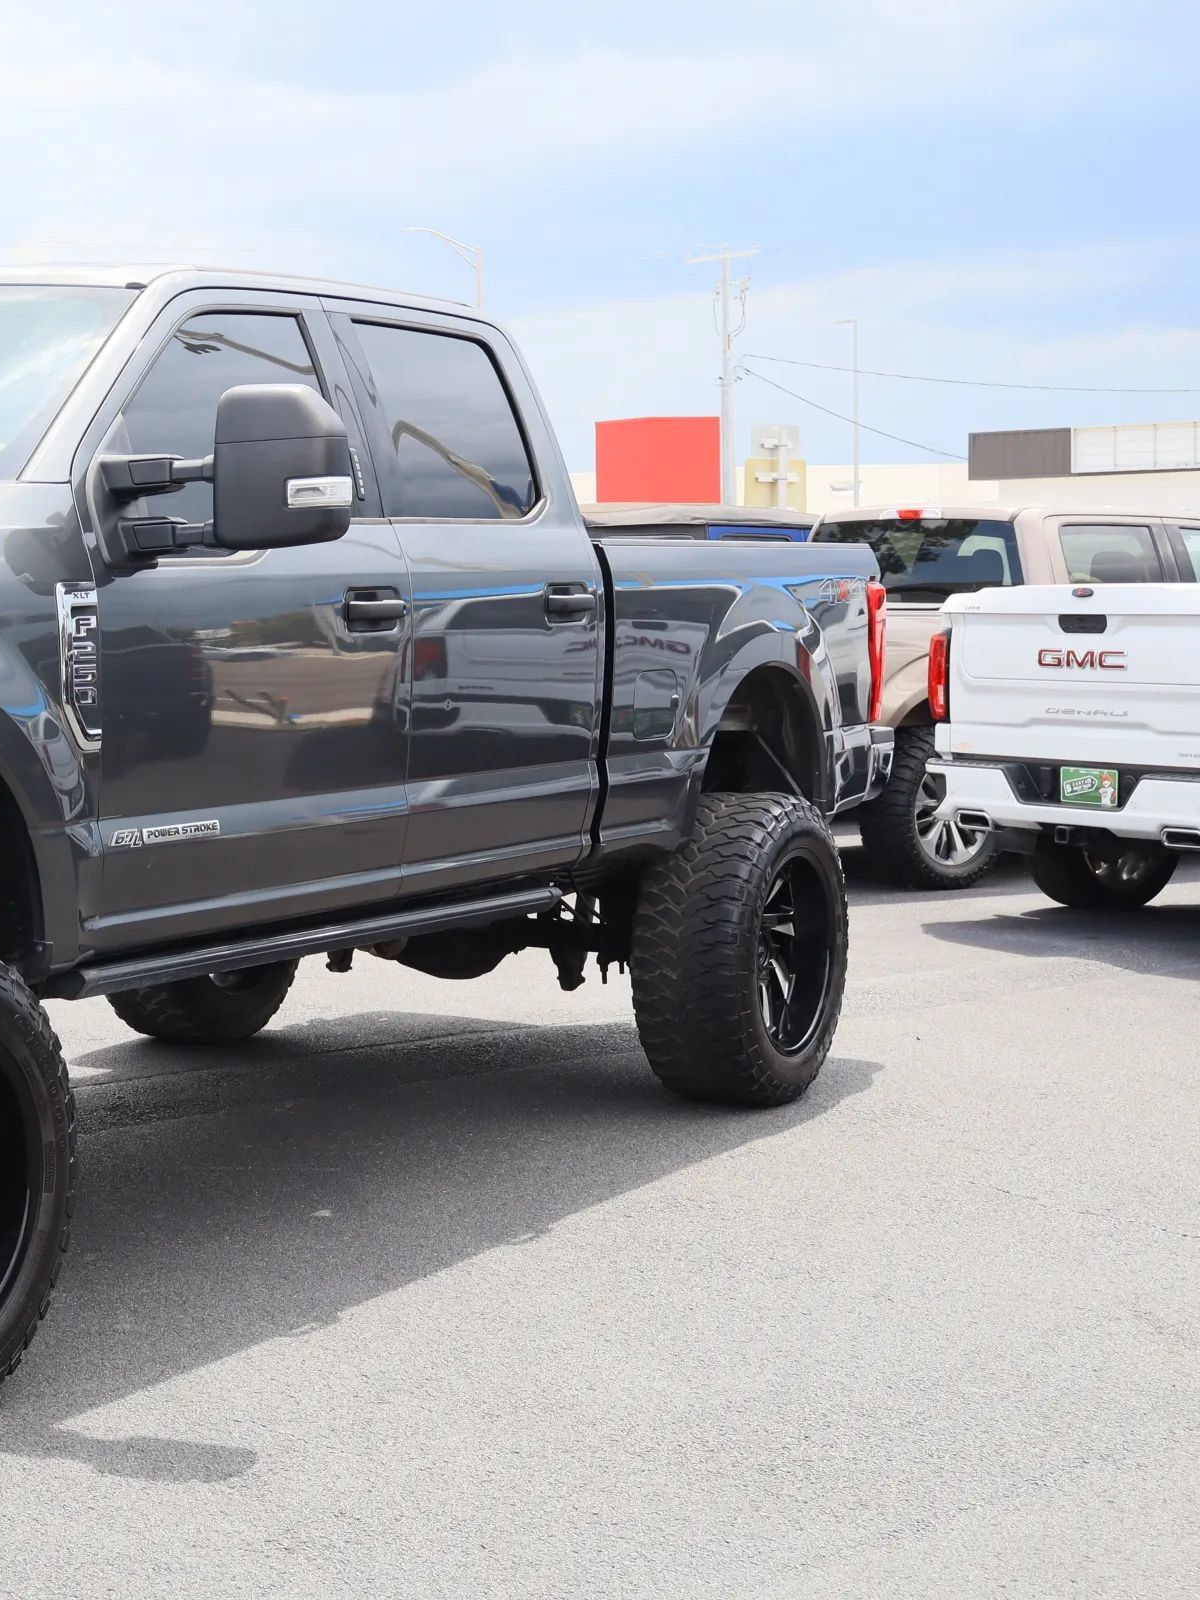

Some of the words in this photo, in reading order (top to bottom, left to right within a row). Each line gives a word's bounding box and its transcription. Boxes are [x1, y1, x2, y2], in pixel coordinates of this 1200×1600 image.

[72, 592, 90, 600] XLT
[1037, 648, 1128, 671] GMC
[1045, 707, 1128, 717] DENALI
[146, 828, 180, 839] POWER
[182, 822, 218, 835] STROKE
